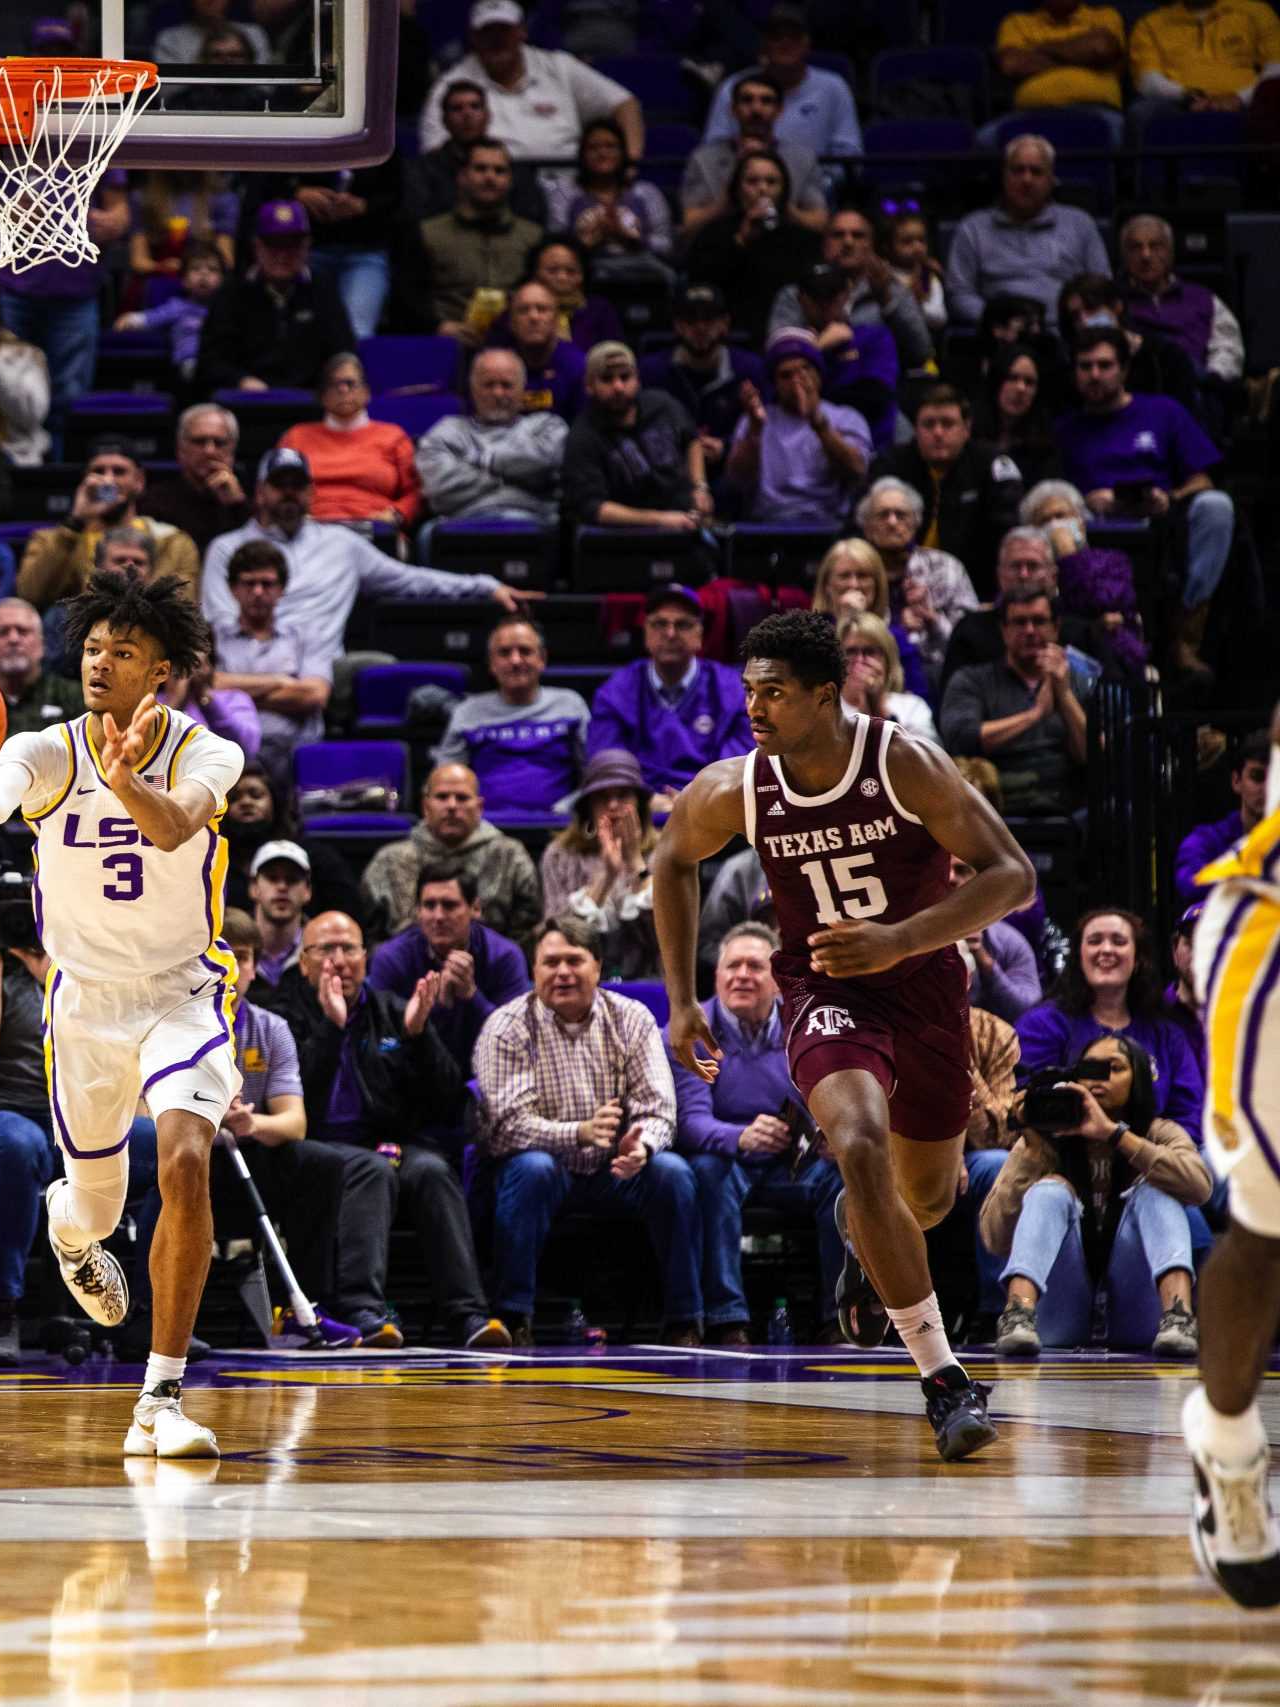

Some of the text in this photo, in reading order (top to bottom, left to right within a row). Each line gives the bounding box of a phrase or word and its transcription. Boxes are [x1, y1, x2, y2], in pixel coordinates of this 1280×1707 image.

[63, 813, 155, 849] LS
[763, 815, 898, 858] TEXAS A&M
[102, 852, 144, 901] 3
[800, 852, 889, 925] 15
